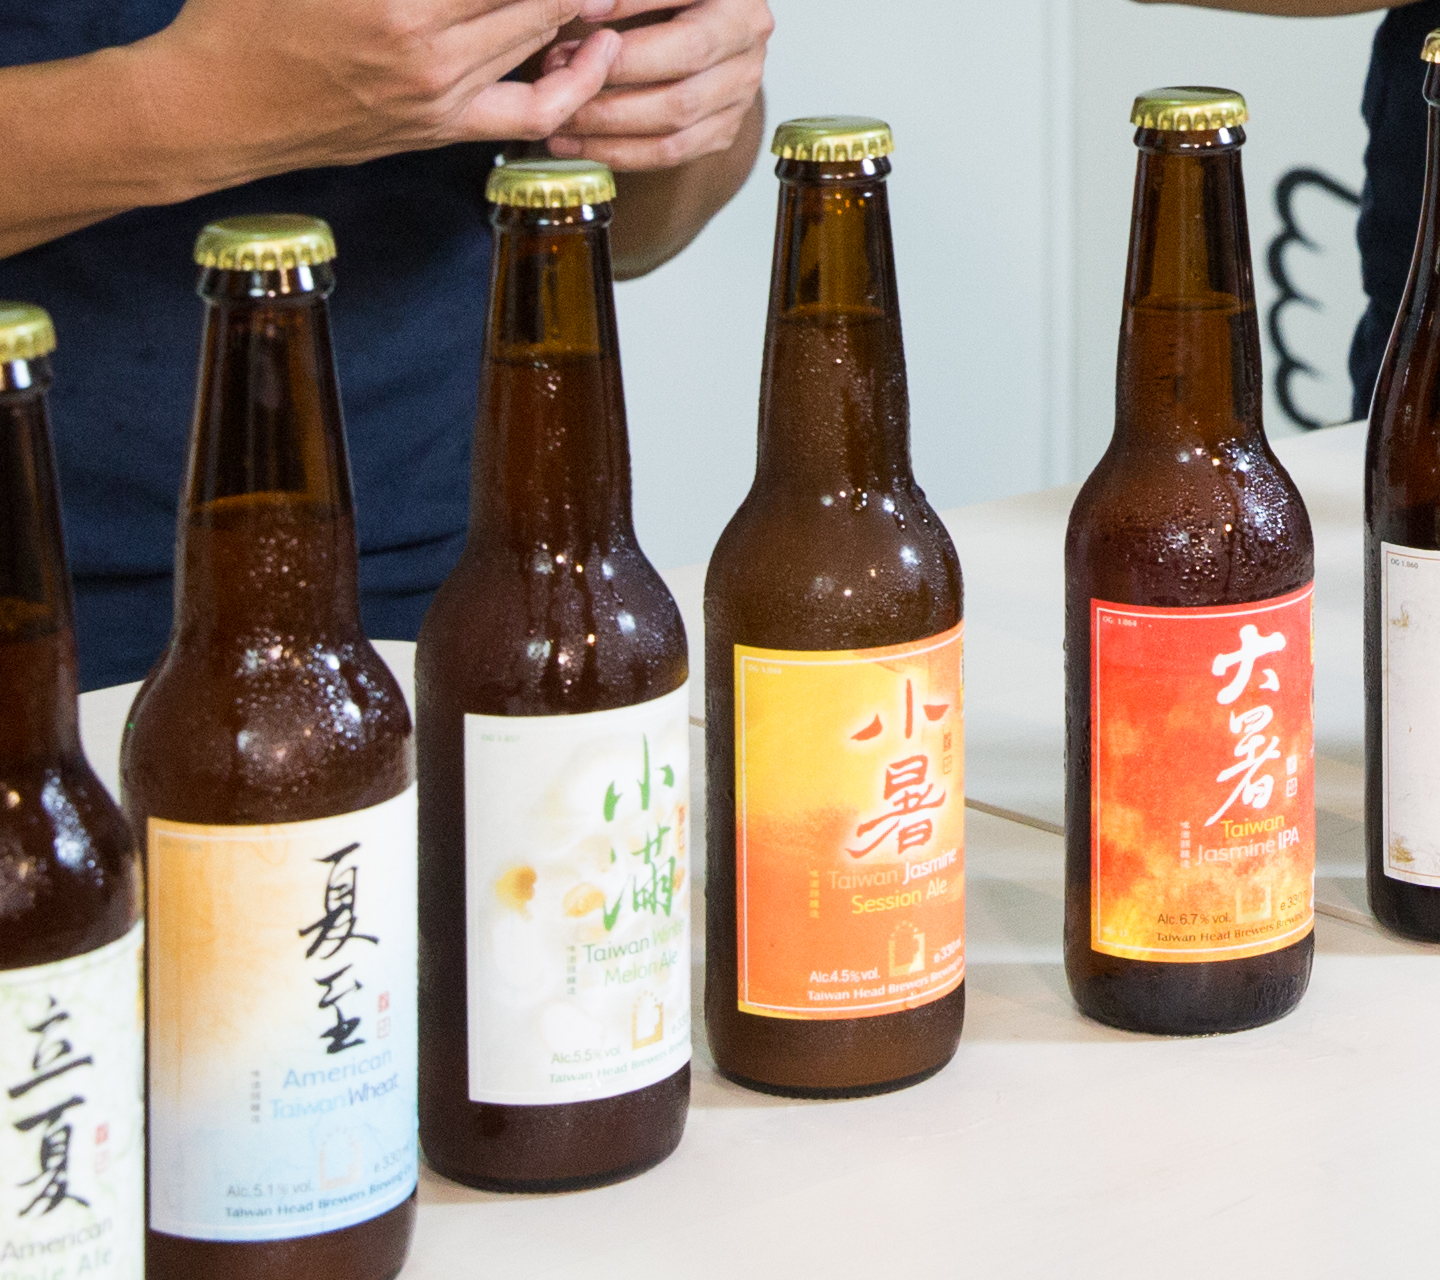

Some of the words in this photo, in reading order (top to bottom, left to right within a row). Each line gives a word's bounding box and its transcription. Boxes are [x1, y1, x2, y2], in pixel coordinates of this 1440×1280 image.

[1205, 624, 1287, 827] 大暑
[844, 677, 951, 859] 小暑
[603, 731, 676, 932] 小滿
[1194, 838, 1276, 867] Jasmine
[1277, 826, 1300, 851] IPA
[1220, 814, 1285, 839] Taiwan
[828, 869, 898, 890] Taiwan
[901, 848, 957, 886] Jasmine
[851, 889, 923, 915] Session
[926, 877, 948, 900] Ale
[1156, 930, 1196, 942] Taiwan
[1200, 929, 1231, 941] Head
[1234, 921, 1275, 939] Brewers
[1212, 911, 1232, 924] vol.
[298, 842, 379, 1056] 夏至
[583, 937, 650, 964] Taiwan
[604, 959, 659, 988] Melon
[660, 947, 679, 968] Ale
[806, 989, 851, 1002] Taiwan
[853, 984, 886, 999] Head
[888, 974, 929, 994] Brewers
[861, 966, 881, 981] vol.
[281, 1049, 393, 1090] American
[549, 1070, 593, 1084] Taiwan
[597, 1063, 628, 1078] Head
[7, 994, 94, 1218] 立夏
[269, 1094, 347, 1120] Taiwan
[347, 1071, 400, 1106] Wheat
[224, 1205, 272, 1220] Taiwan
[277, 1200, 314, 1215] Head
[318, 1186, 366, 1210] Brewers
[0, 1216, 114, 1264] American
[76, 1244, 113, 1274] Ale
